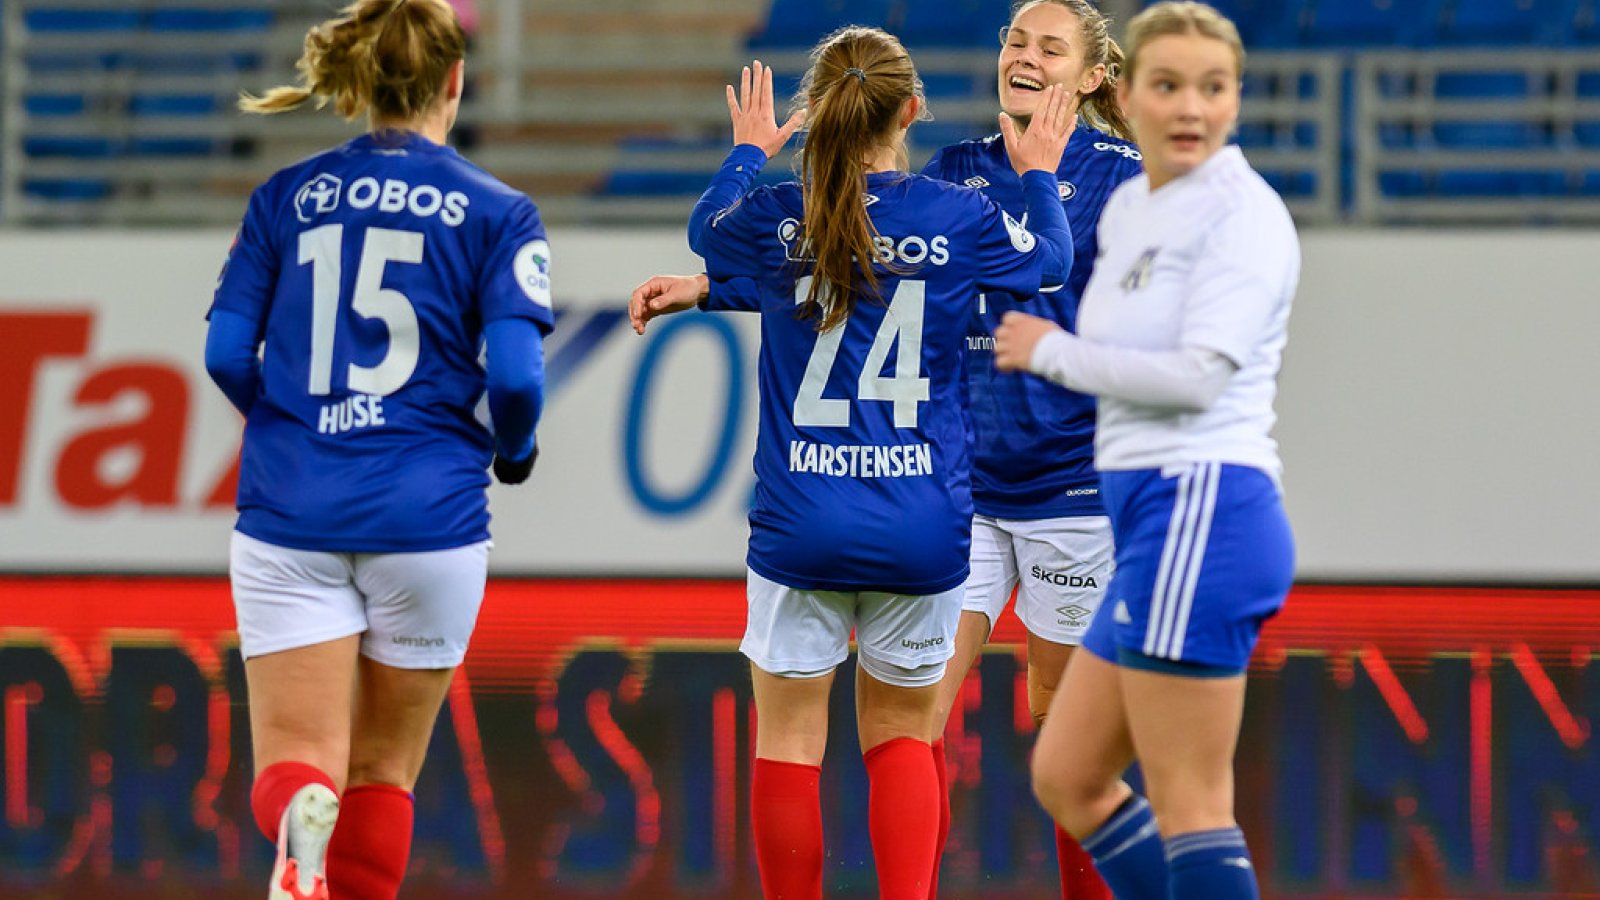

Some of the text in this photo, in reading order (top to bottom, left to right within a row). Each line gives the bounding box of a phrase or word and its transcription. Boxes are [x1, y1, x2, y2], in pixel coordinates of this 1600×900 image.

[346, 176, 469, 227] OBOS
[850, 234, 950, 266] BOS
[526, 274, 548, 290] OB
[297, 223, 425, 397] 15
[793, 273, 930, 429] 24
[0, 309, 242, 513] Ta
[317, 394, 386, 434] HUSE
[788, 440, 933, 478] KARSTENSEN
[391, 635, 446, 648] umbro
[1056, 618, 1088, 628] umbro
[901, 635, 945, 651] umbro
